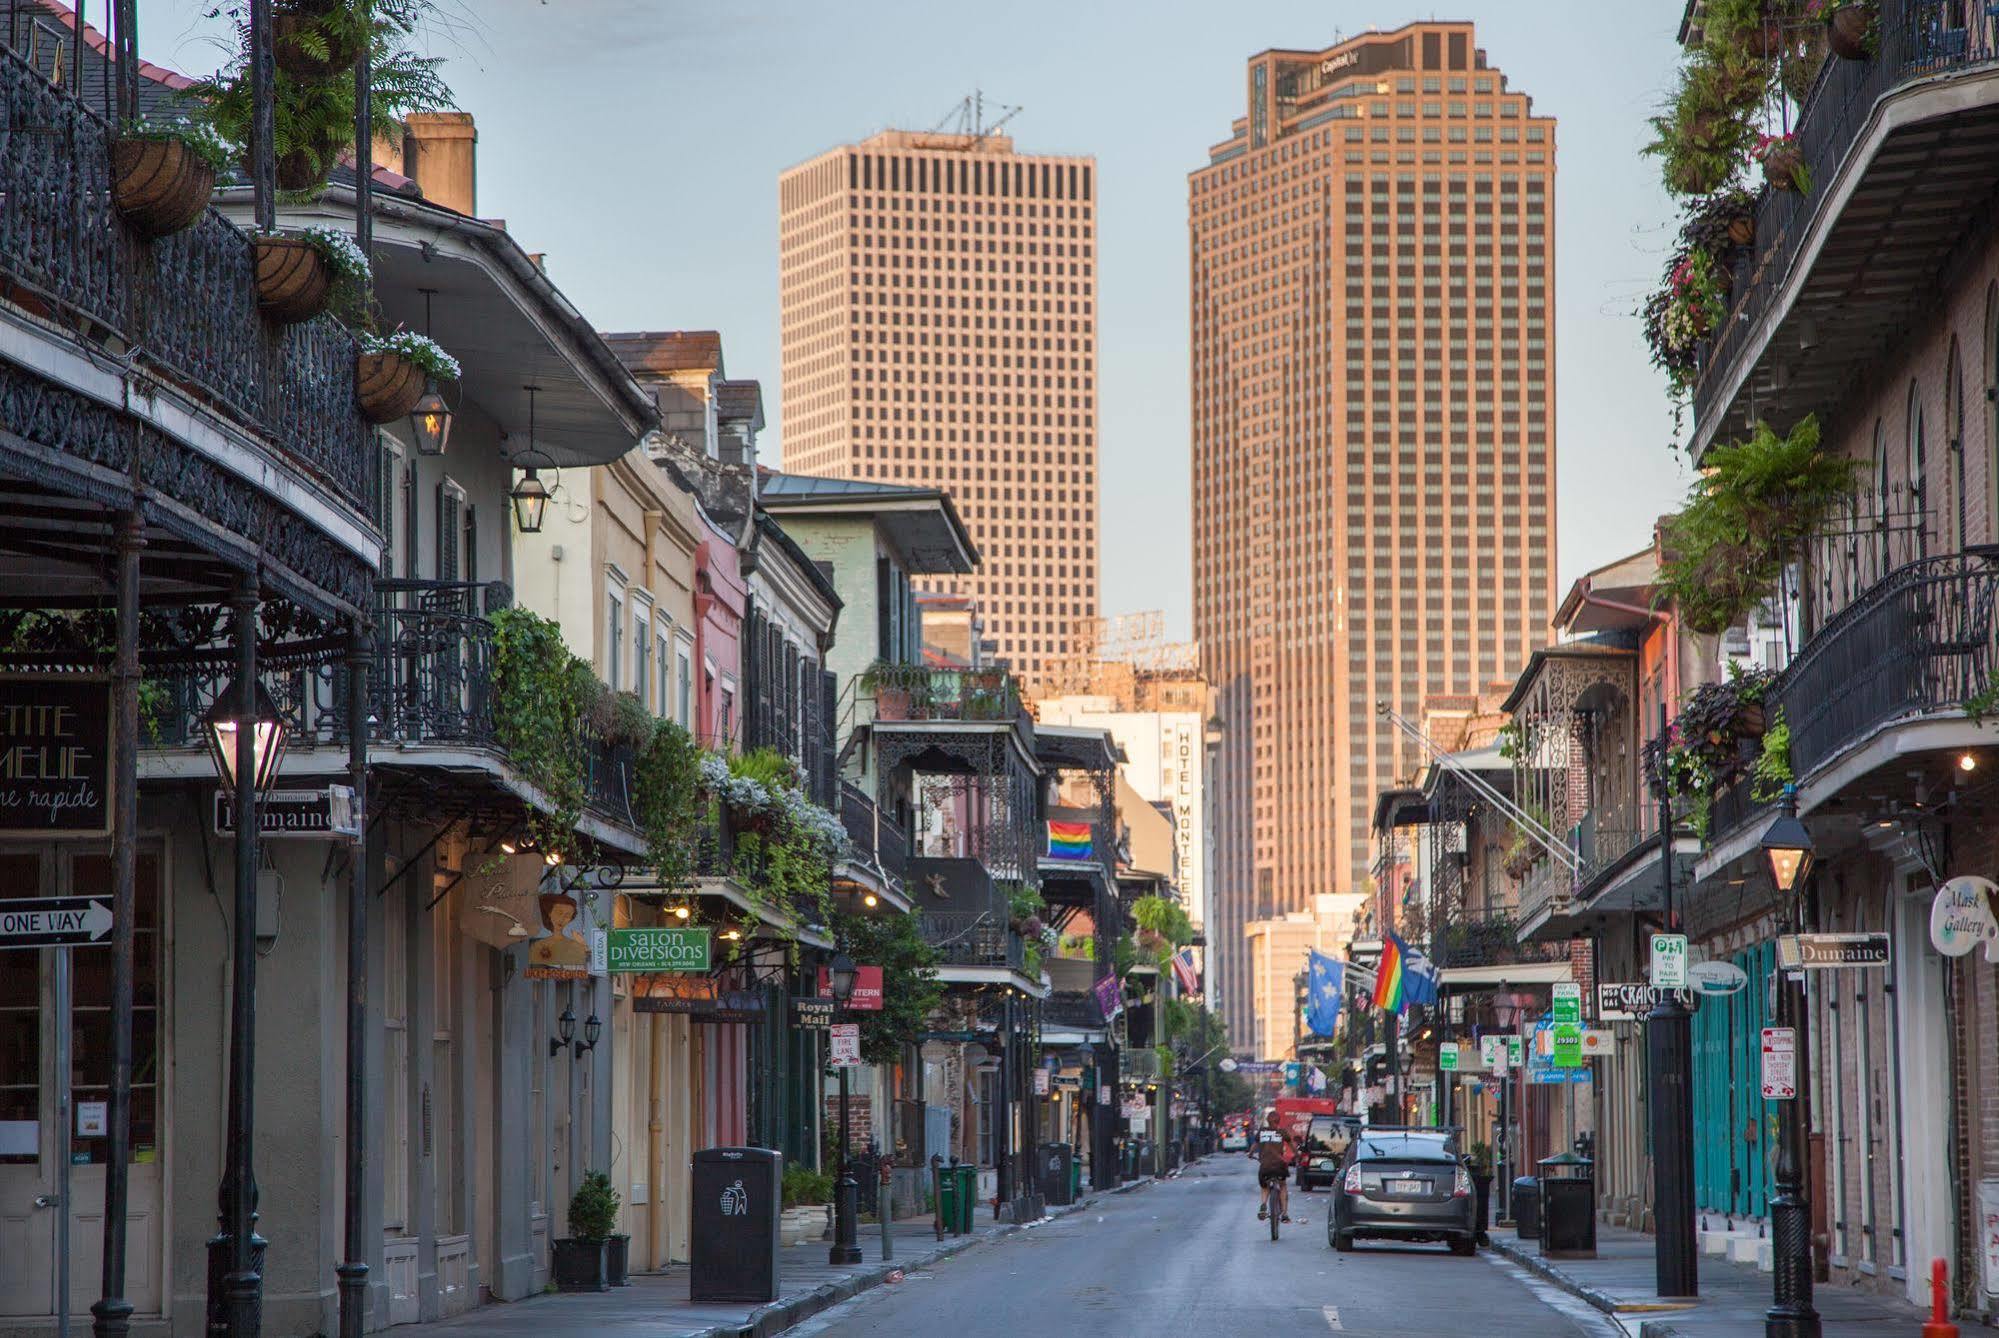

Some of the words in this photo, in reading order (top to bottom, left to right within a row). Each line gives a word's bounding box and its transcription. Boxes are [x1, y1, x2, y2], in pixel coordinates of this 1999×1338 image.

[1179, 732, 1190, 795] HOTEL
[28, 781, 99, 823] rapide
[1946, 891, 1979, 908] Mask
[4, 913, 40, 932] ONE
[48, 911, 86, 930] WAY
[1945, 915, 1985, 938] Gallery
[1801, 944, 1885, 961] Dumaine
[820, 988, 833, 996] RE
[1620, 985, 1656, 1005] CRAIG
[797, 1002, 834, 1013] Royal
[801, 1014, 830, 1024] Mail
[838, 1038, 853, 1046] FIRE
[837, 1047, 854, 1055] LANE
